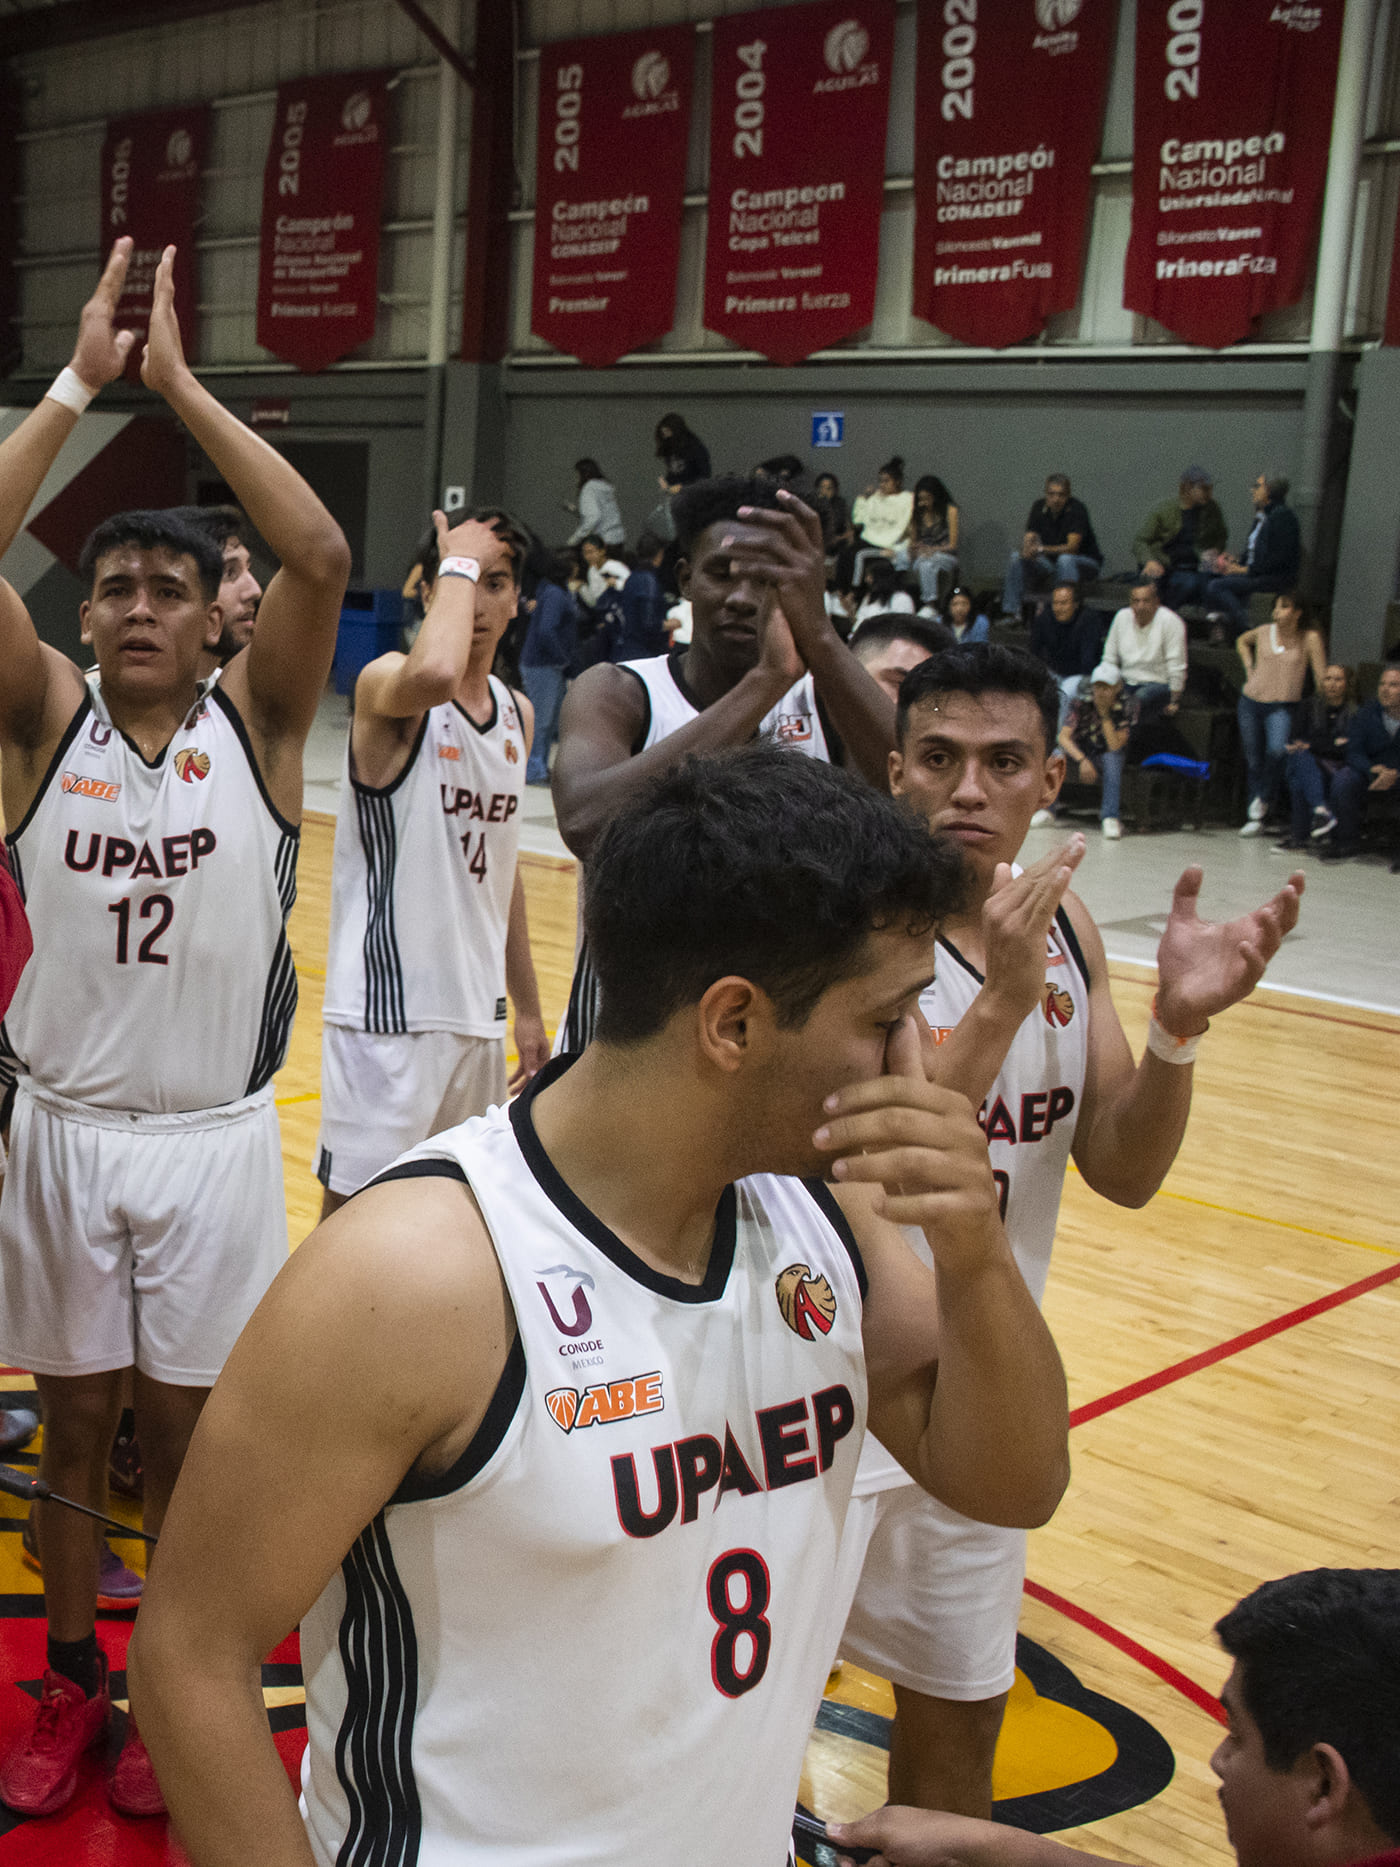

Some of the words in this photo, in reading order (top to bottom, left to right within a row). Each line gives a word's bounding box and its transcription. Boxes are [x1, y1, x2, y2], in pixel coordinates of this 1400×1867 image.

[941, 0, 978, 121] 2002
[554, 63, 583, 172] 2005
[733, 39, 767, 158] 2004
[937, 170, 1033, 204] Nacional
[729, 203, 820, 234] Nacional
[71, 776, 122, 803] ABE
[441, 784, 519, 822] UPAEP
[64, 827, 217, 880] UPAEP
[460, 831, 487, 883] 14
[108, 893, 175, 966] 12
[558, 1339, 605, 1357] CONDDE
[574, 1370, 665, 1430] ABE
[609, 1383, 856, 1539] UPAEP
[705, 1547, 771, 1699] 8
